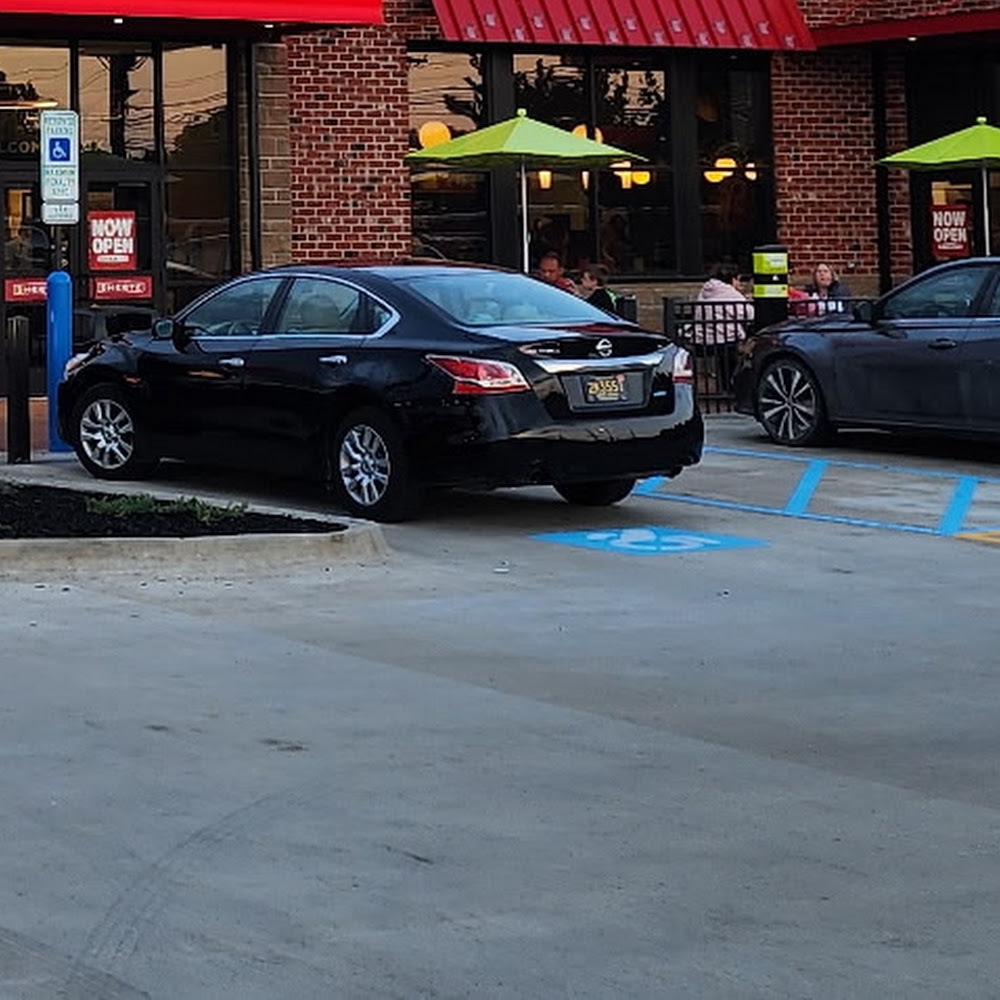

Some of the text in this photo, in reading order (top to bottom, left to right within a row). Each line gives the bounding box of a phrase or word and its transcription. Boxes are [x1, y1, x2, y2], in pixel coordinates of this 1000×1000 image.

[933, 211, 966, 226] NOW
[92, 218, 133, 237] NOW
[933, 228, 967, 242] OPEN
[92, 238, 133, 254] OPEN
